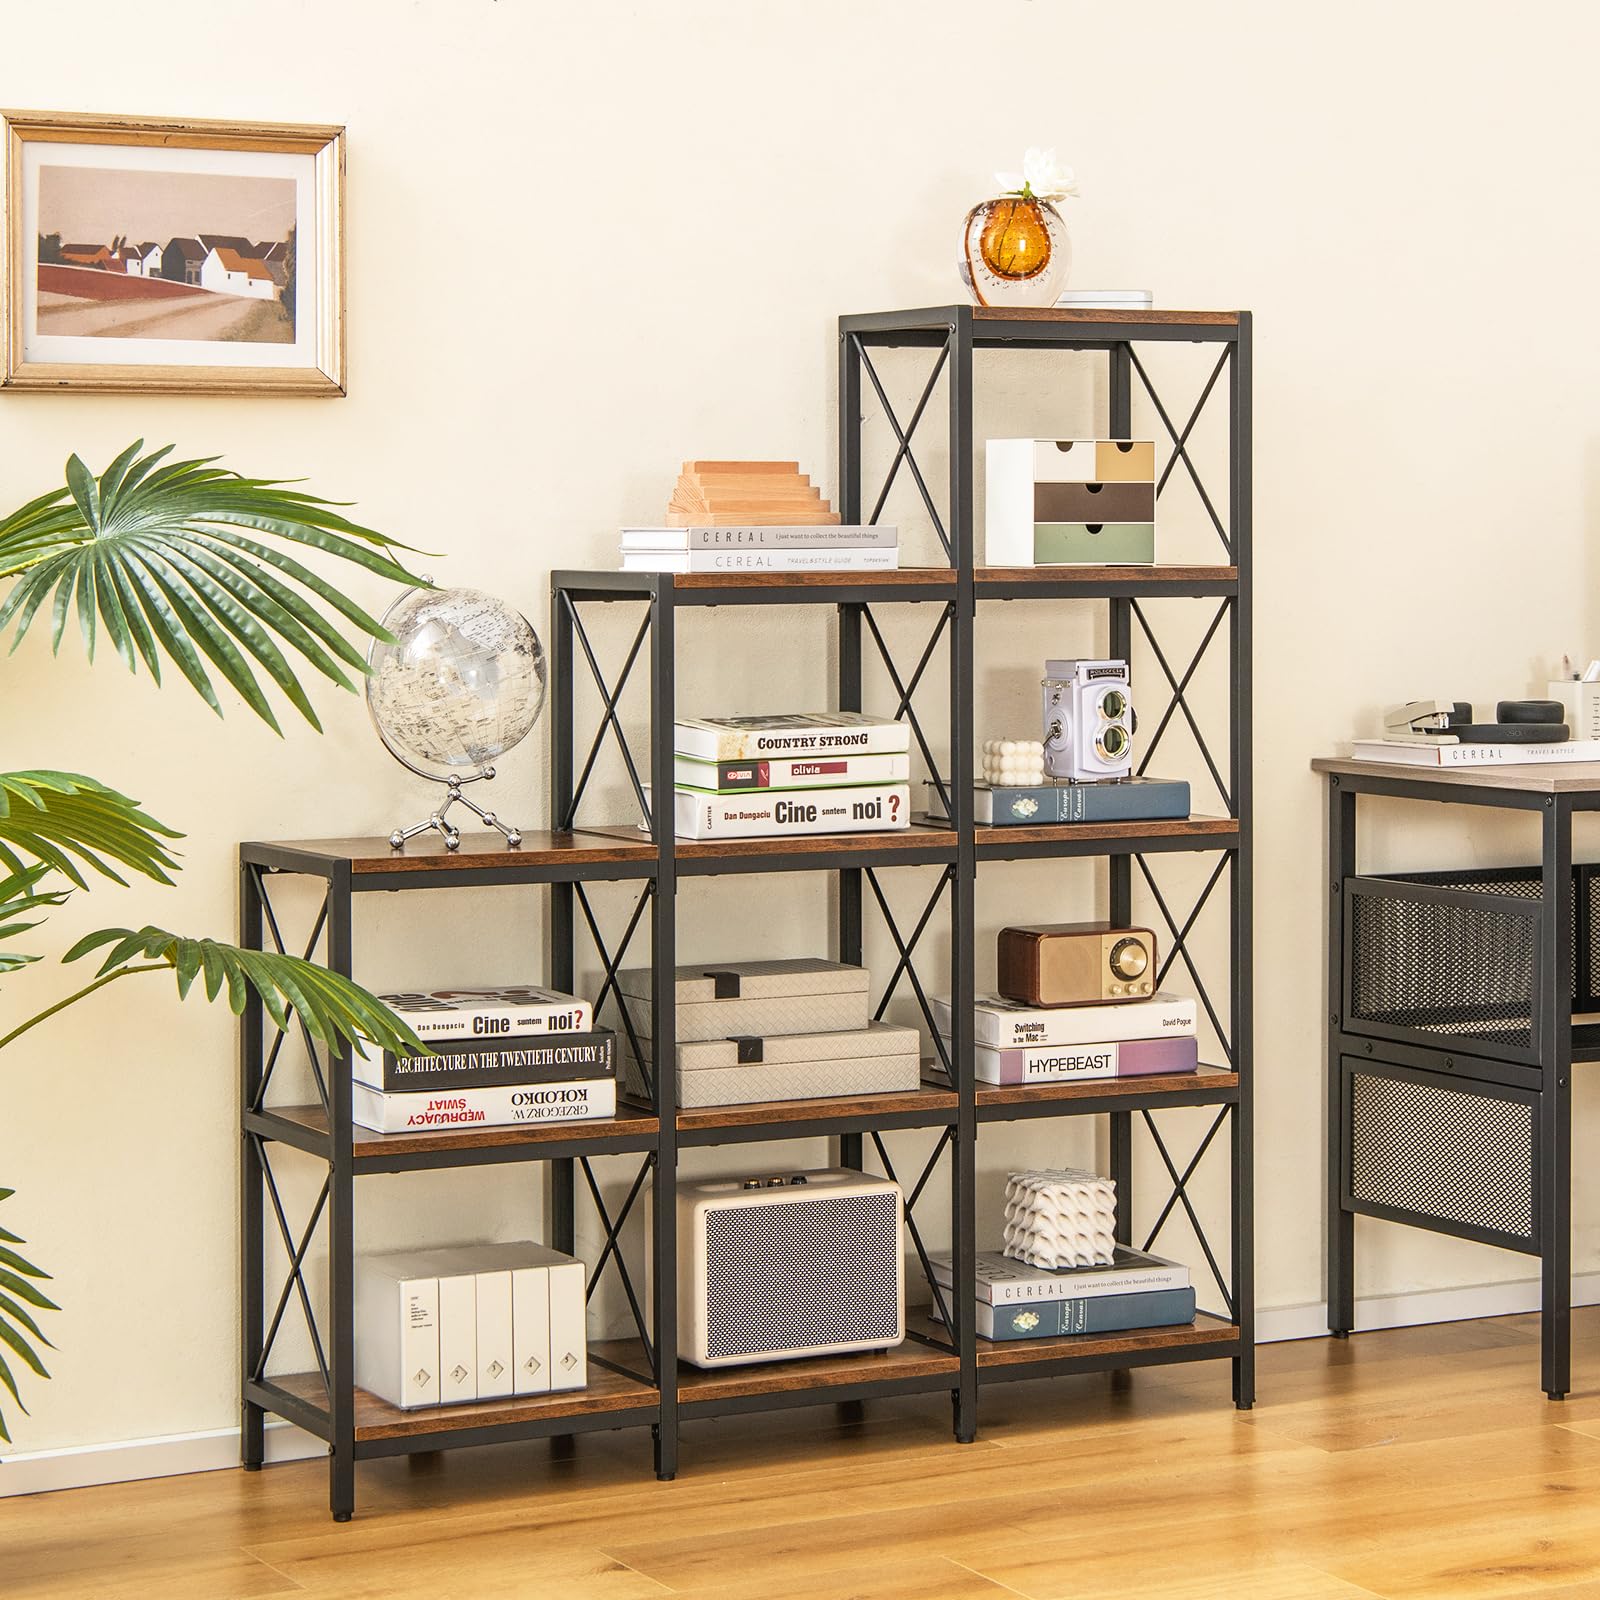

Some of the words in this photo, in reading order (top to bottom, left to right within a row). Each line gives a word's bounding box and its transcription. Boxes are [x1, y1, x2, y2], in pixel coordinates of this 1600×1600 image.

[703, 531, 765, 543] CEREAL
[778, 533, 790, 541] just
[861, 532, 879, 540] things
[715, 556, 773, 567] CEREAL
[757, 735, 817, 750] COUNTRY
[819, 733, 869, 747] STRONG
[1453, 749, 1503, 760] CEREAL
[793, 765, 821, 775] olivia
[724, 812, 738, 820] Dan
[775, 801, 817, 824] Cine
[852, 797, 882, 820] noi
[472, 1016, 510, 1034] Cine
[1014, 1021, 1045, 1034] Switching
[1162, 1018, 1176, 1027] David
[1025, 1033, 1039, 1043] Mac
[468, 1053, 479, 1069] IN
[480, 1051, 499, 1068] THE
[500, 1049, 554, 1068] TWENTIETH
[554, 1046, 598, 1064] CENTURY
[1029, 1054, 1112, 1074] HYPEBEAST
[511, 1088, 588, 1106] KOŁODKO
[427, 1098, 467, 1111] ŚWIAT
[527, 1105, 589, 1119] GRZEGORZ
[1132, 1277, 1155, 1285] beautiful
[1005, 1284, 1064, 1299] CEREAL
[1061, 1302, 1071, 1334] Europe
